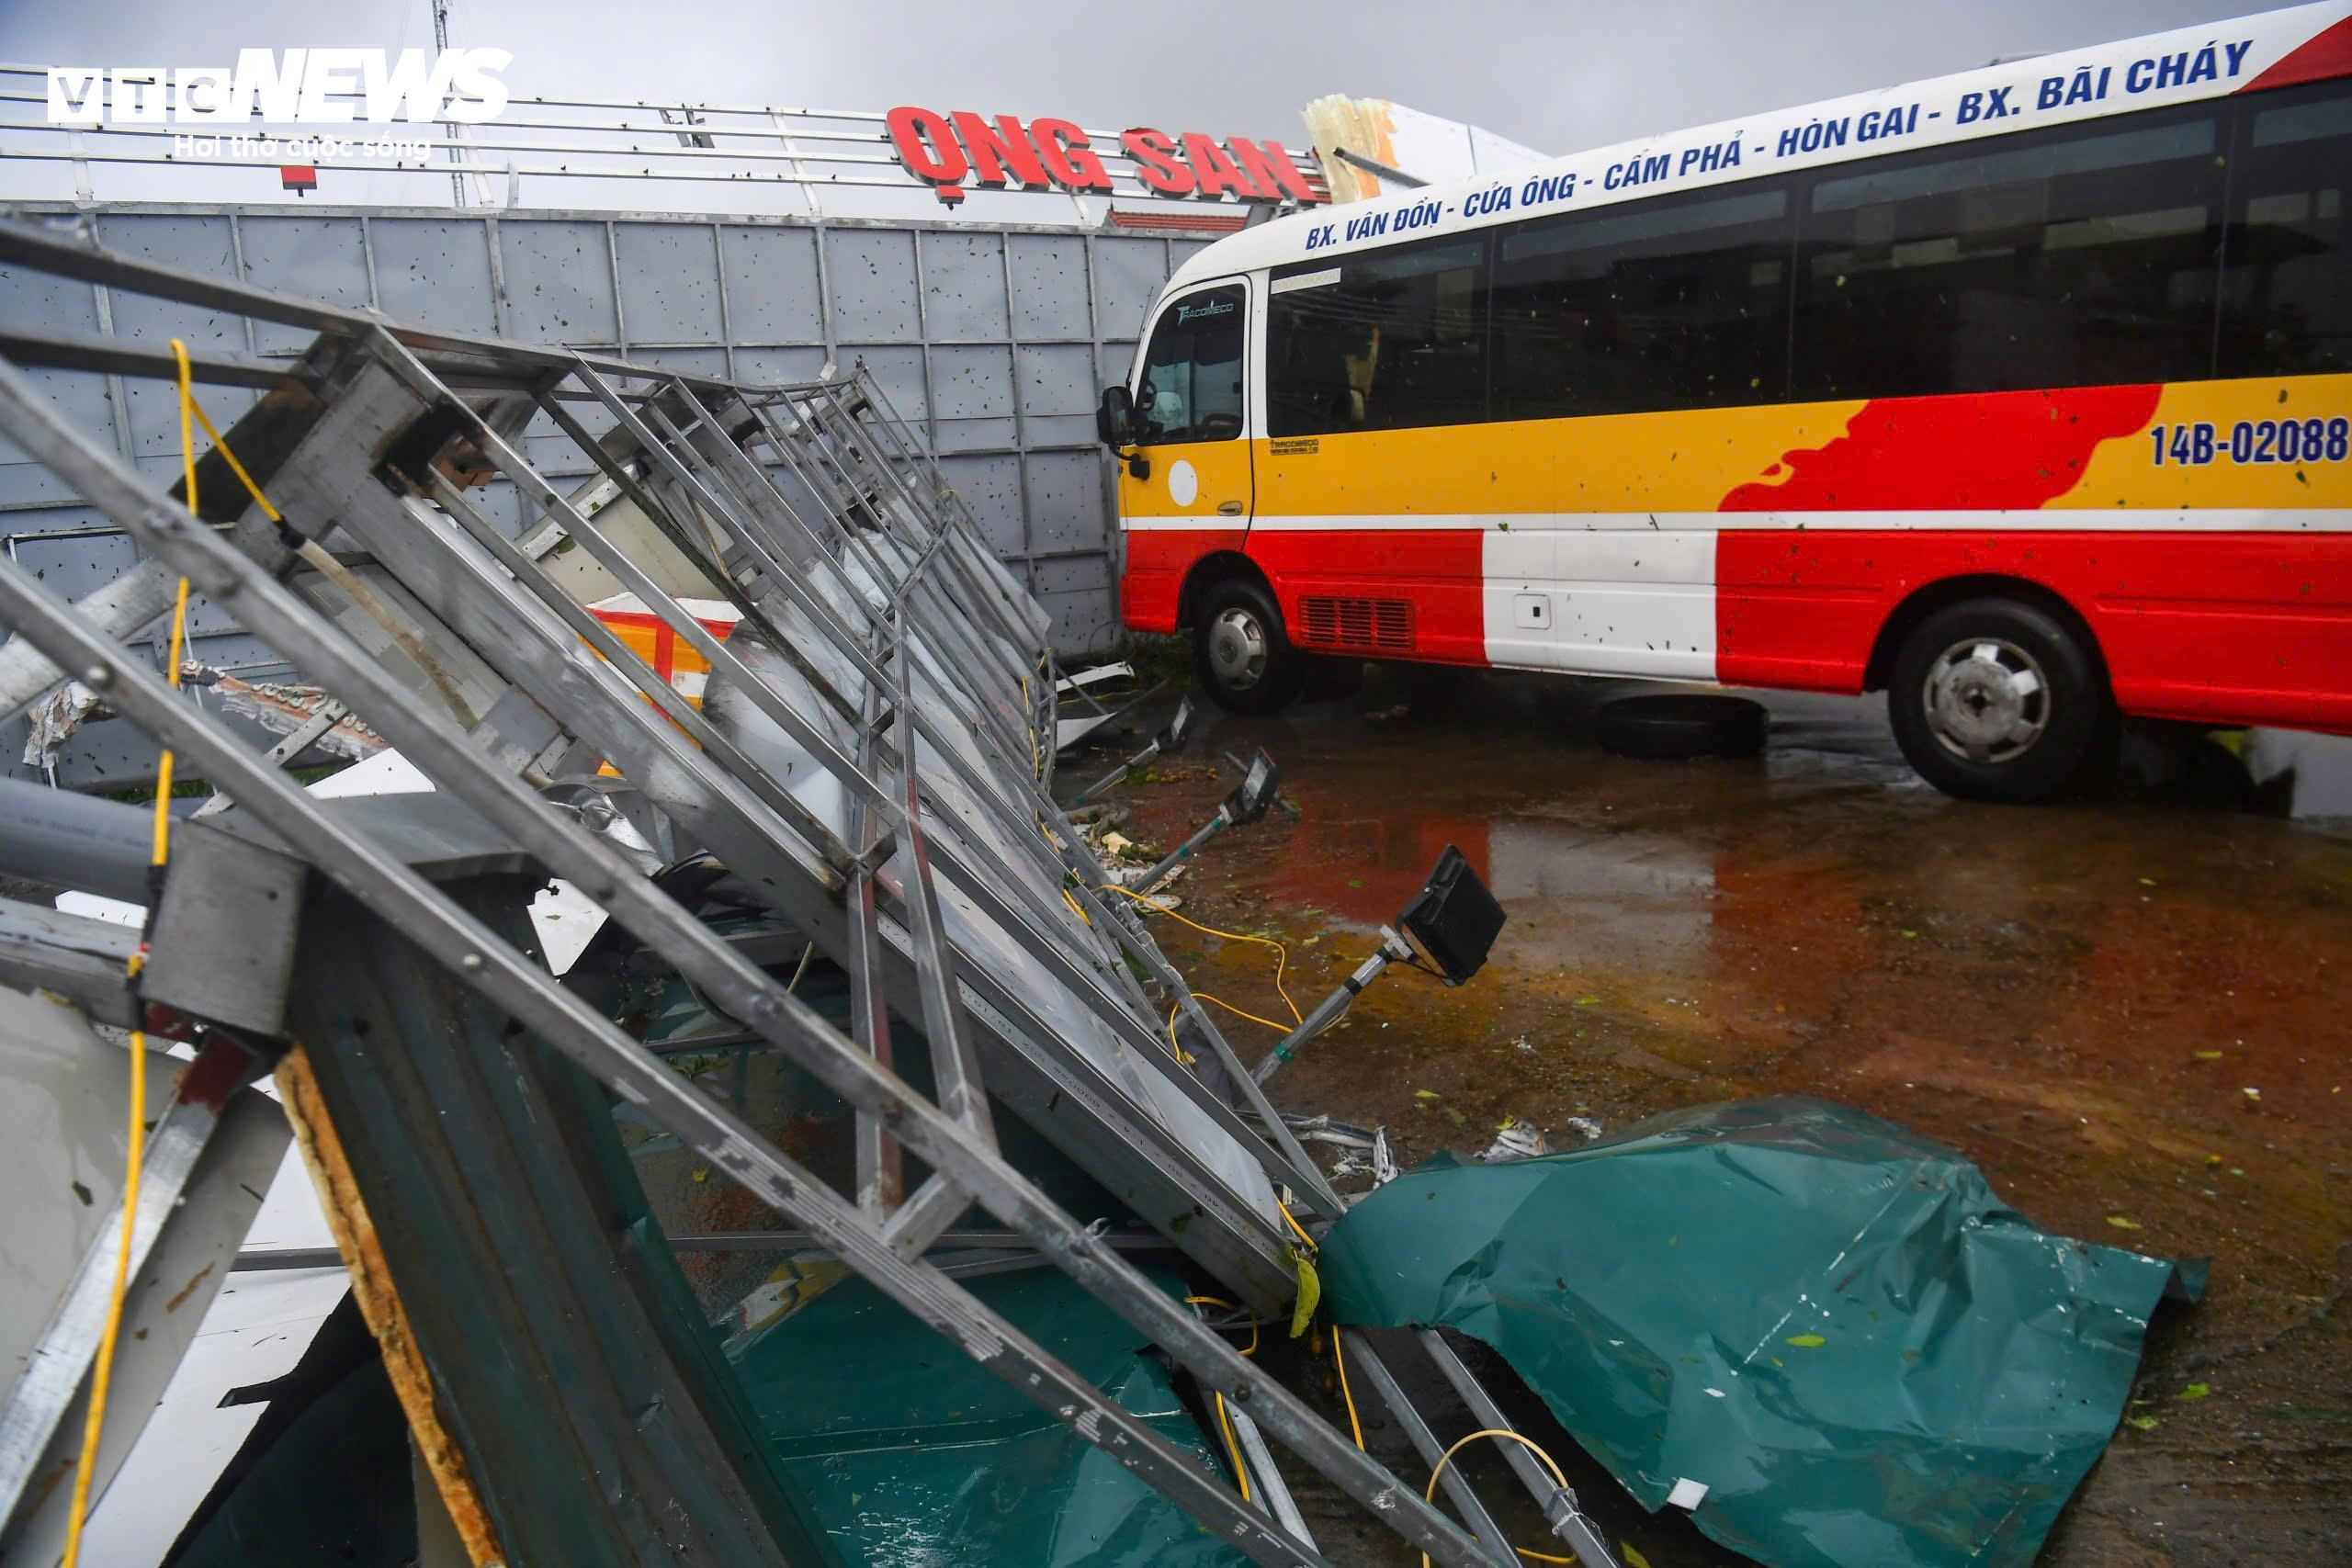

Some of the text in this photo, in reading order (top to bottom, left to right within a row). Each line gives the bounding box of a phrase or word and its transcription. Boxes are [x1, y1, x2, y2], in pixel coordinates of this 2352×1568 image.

[1119, 127, 1318, 208] SAN
[1306, 228, 1337, 250] BX.
[1346, 212, 1388, 242] VÂN
[1464, 181, 1511, 218] CỬA
[1521, 175, 1576, 206] ÔNG
[1679, 130, 1744, 176] PHẢ
[1777, 118, 1849, 157] HÒN
[1857, 103, 1919, 141] GAI
[1956, 85, 2020, 125] BX.
[2036, 65, 2112, 110] BÃI
[2126, 39, 2254, 94] CHÁY
[2150, 417, 2350, 466] 14B-02088
